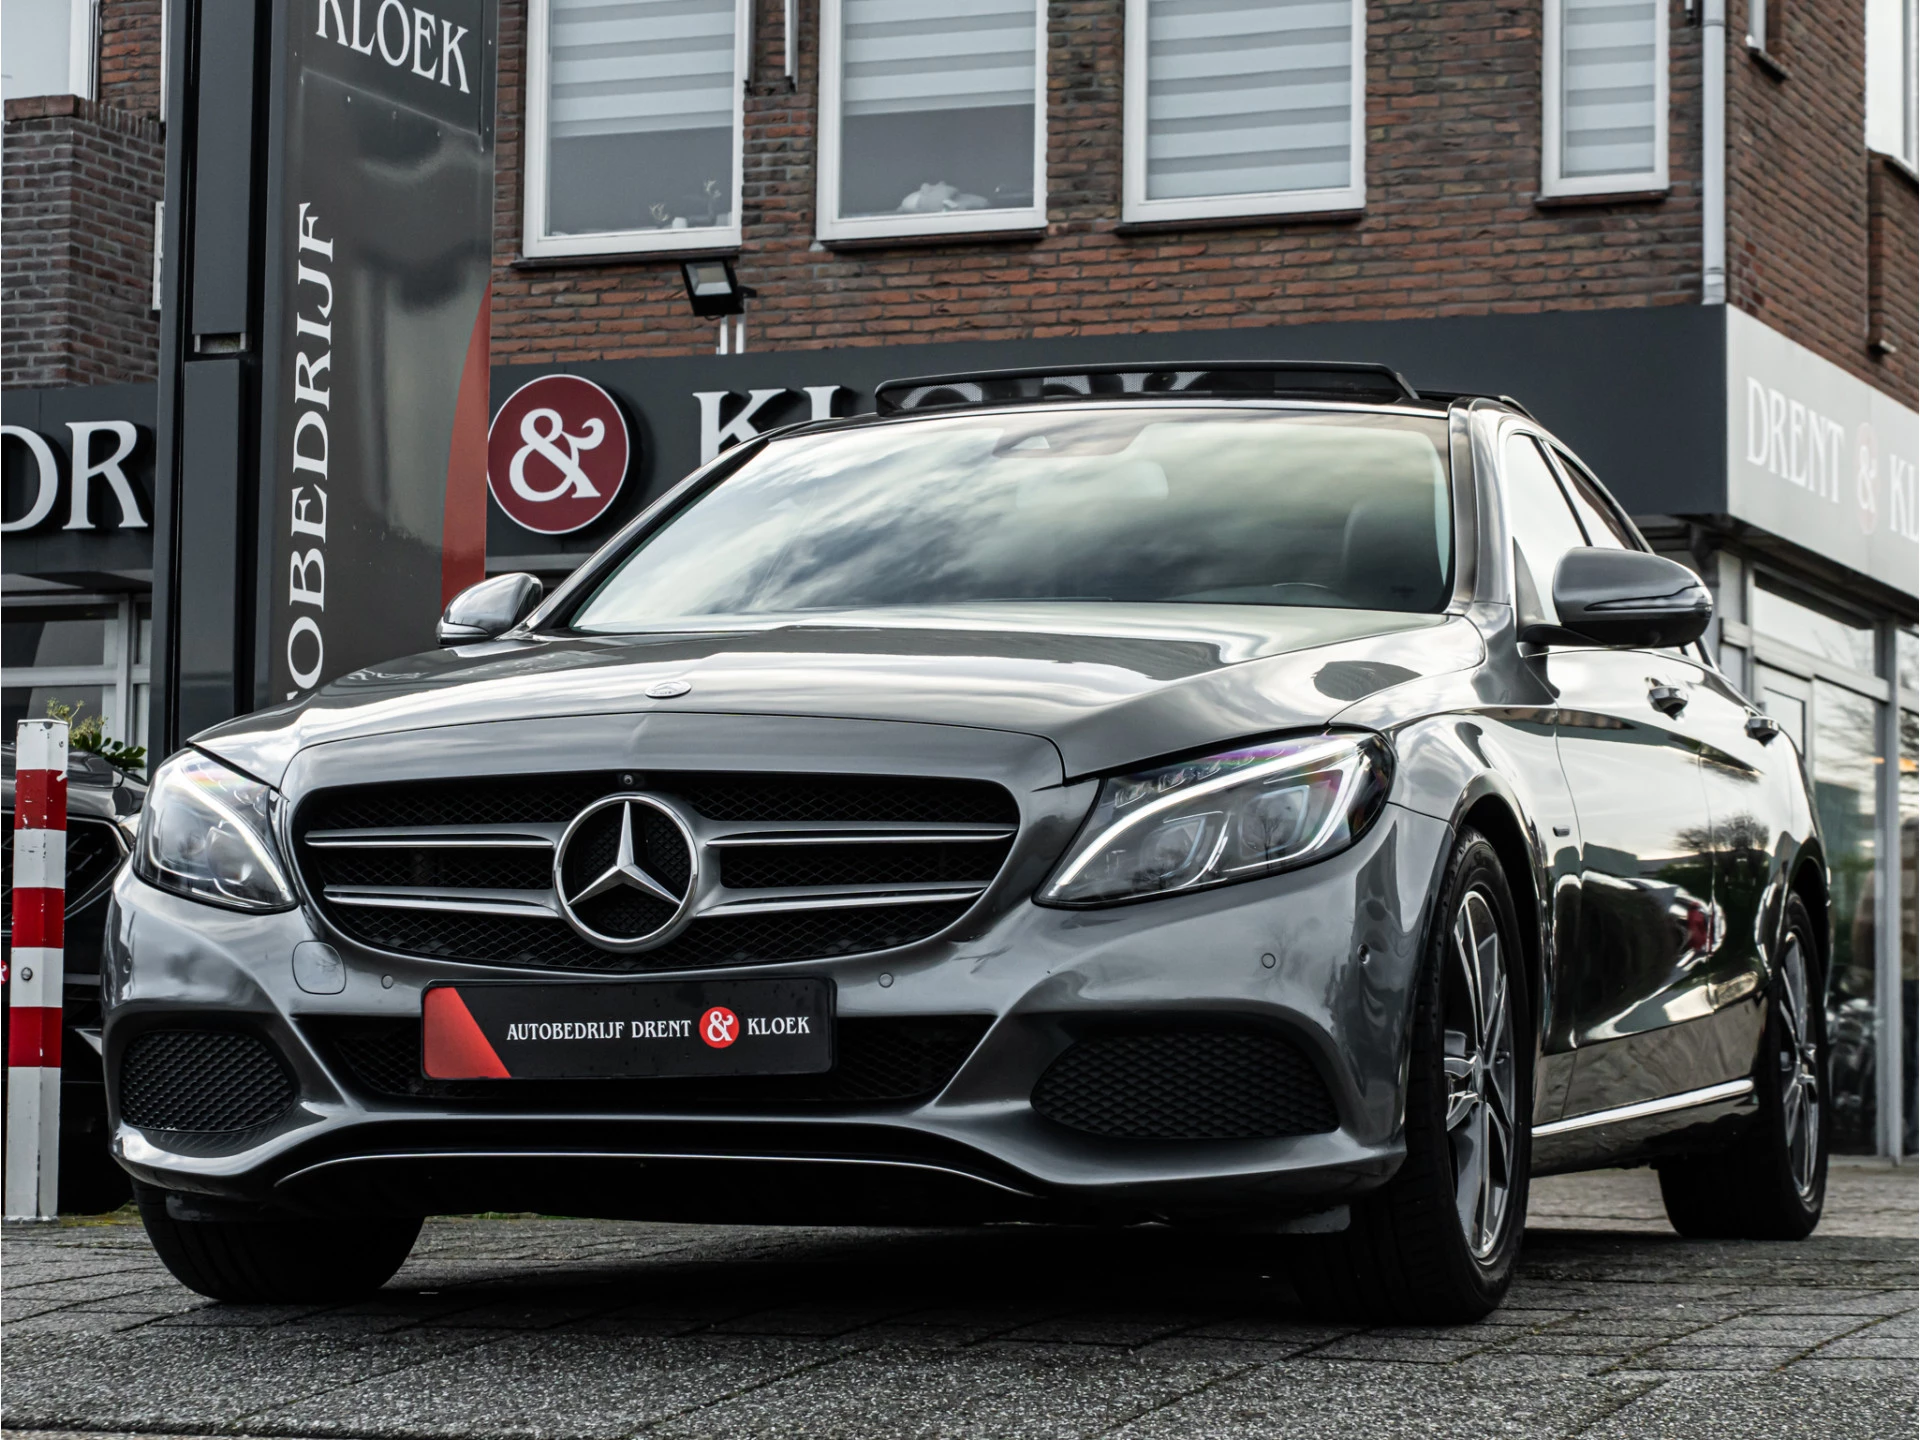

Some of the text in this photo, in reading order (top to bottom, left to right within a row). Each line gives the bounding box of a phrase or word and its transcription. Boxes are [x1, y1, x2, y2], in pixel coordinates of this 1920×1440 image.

[316, 0, 470, 94] KLOEK
[286, 202, 335, 701] OBEDRIJF
[509, 407, 605, 502] &
[1746, 376, 1845, 504] DRENT
[506, 1010, 811, 1042] AUTOBEDRIJF DRENT & KLOEK
